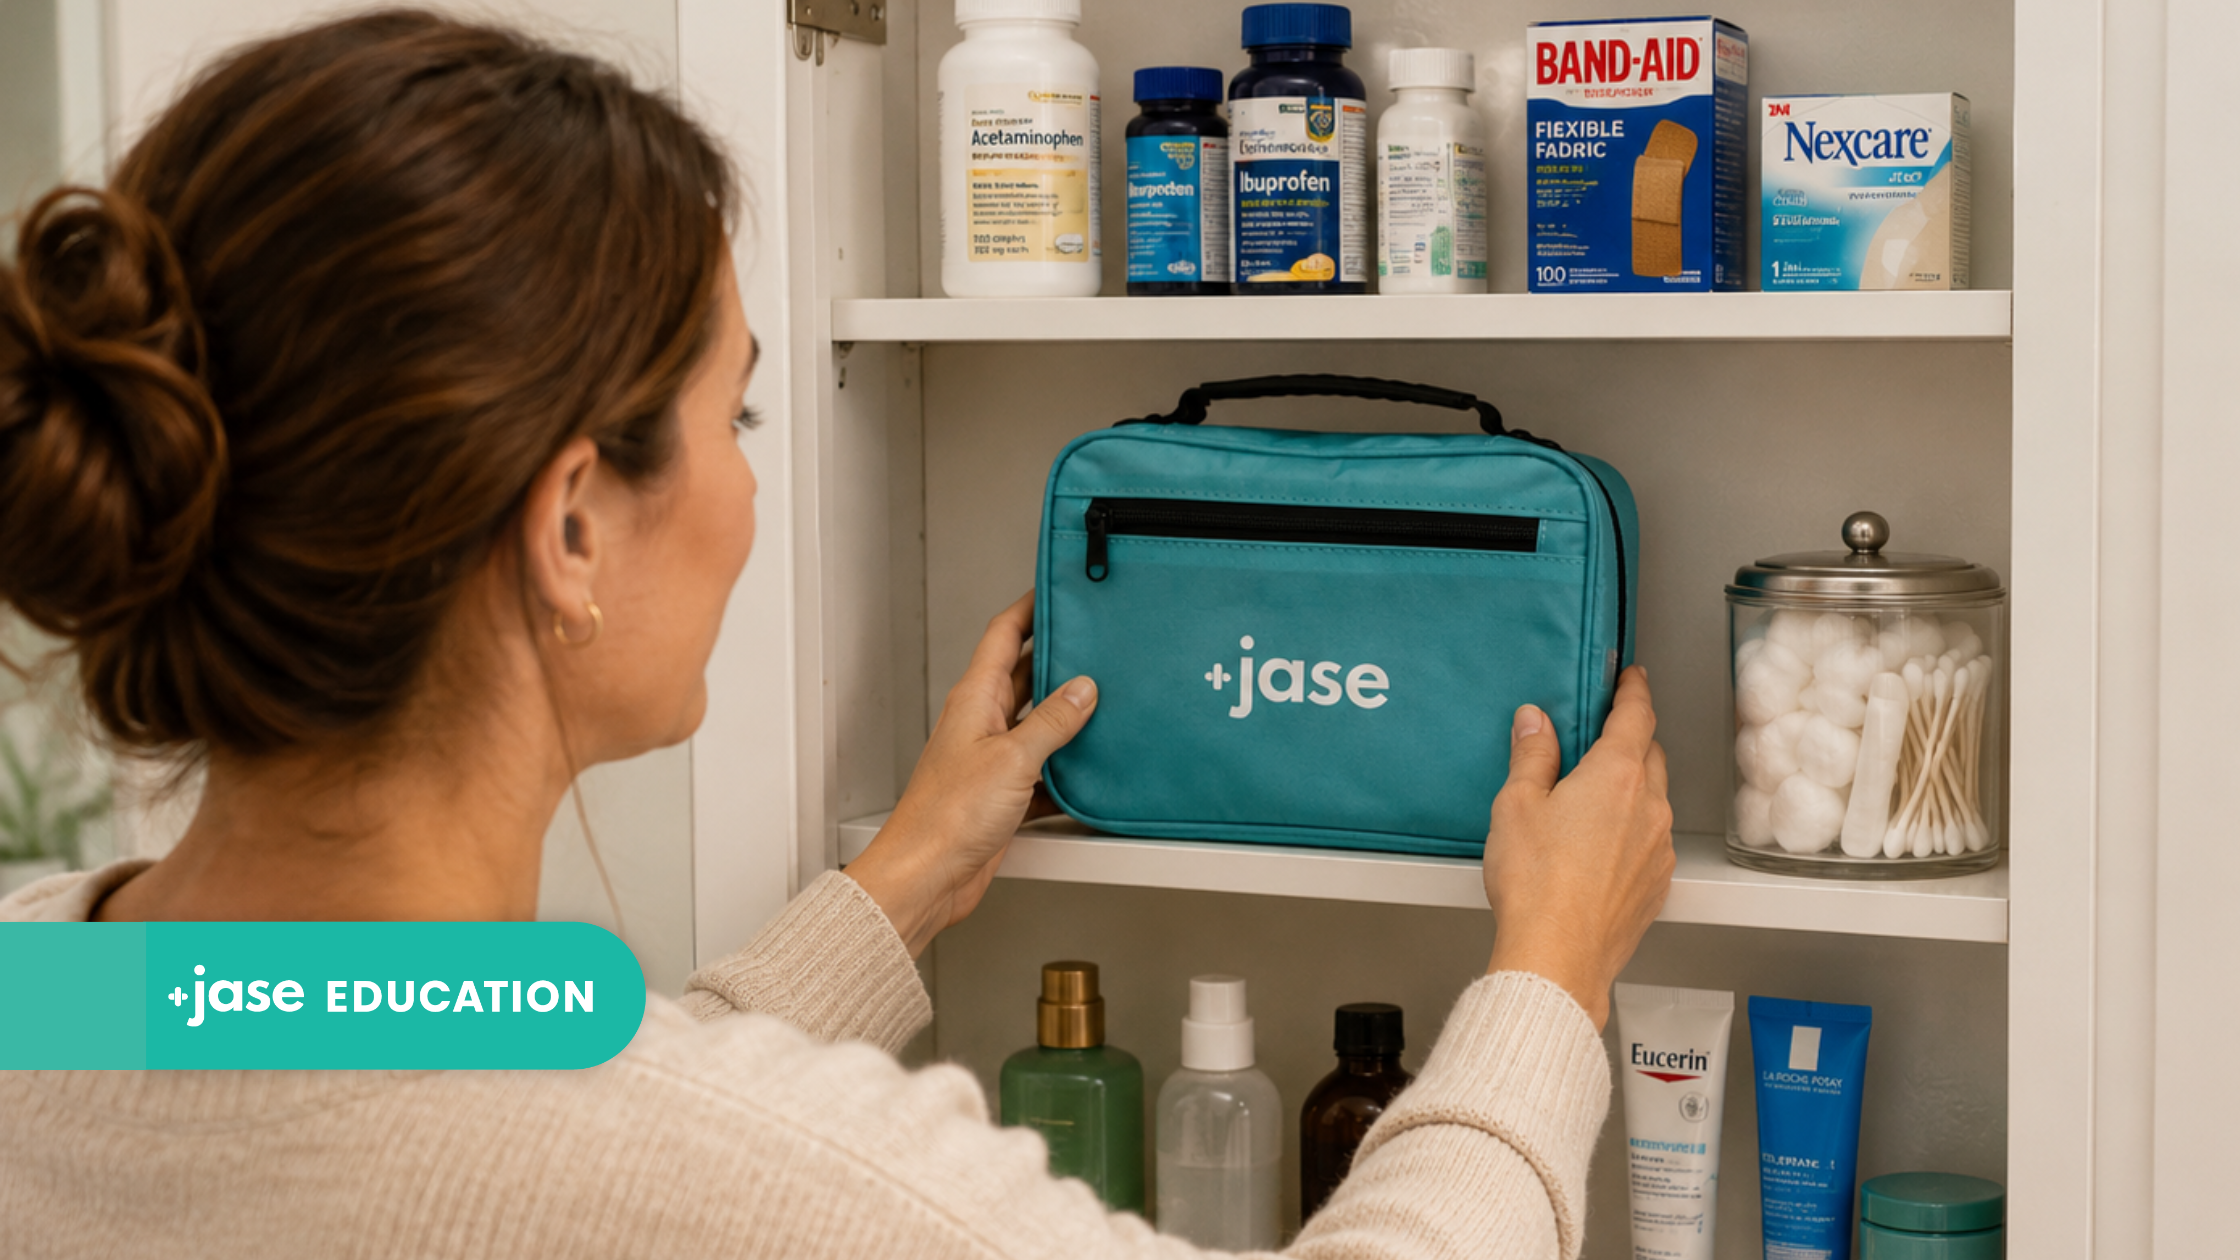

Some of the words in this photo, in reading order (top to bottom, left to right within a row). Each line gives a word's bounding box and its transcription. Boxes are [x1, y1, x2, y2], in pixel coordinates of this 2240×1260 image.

[1536, 37, 1700, 85] BAND-AID
[971, 129, 1083, 150] Acetaminophen
[1784, 121, 1929, 166] Nexcare
[1240, 169, 1330, 196] Ibuprofen
[1536, 266, 1566, 284] 100
[1631, 1042, 1708, 1071] Eucerin
